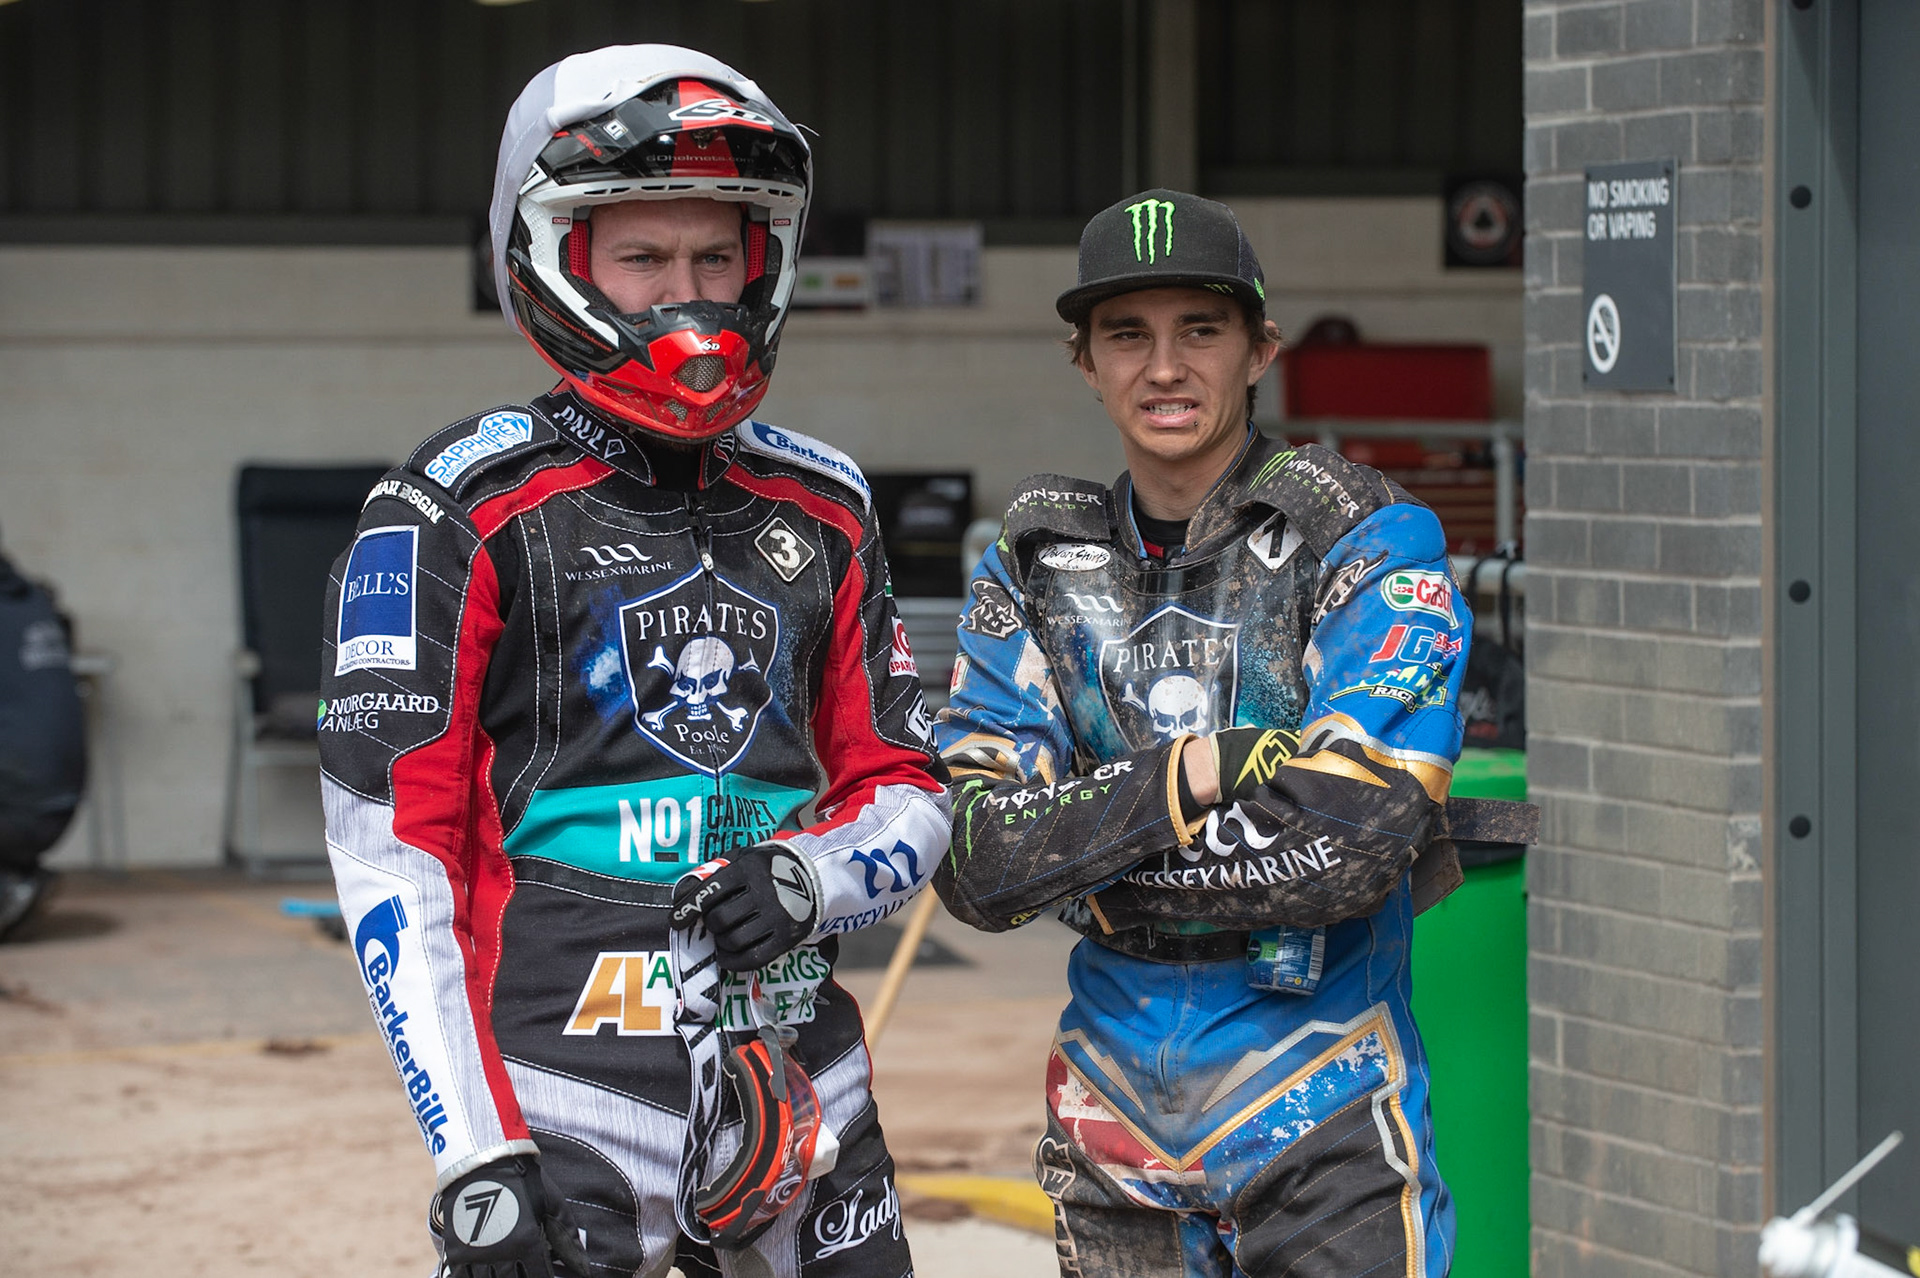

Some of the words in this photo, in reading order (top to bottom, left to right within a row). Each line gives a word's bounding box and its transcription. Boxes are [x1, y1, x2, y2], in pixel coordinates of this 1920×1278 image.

[1588, 181, 1608, 209] NO
[1610, 179, 1670, 206] SMOKING
[1587, 213, 1607, 241] OR
[1609, 211, 1656, 240] VAPING
[427, 424, 516, 480] SAPPHIRE
[442, 445, 493, 485] ENGINEERING
[776, 435, 872, 496] BarkerBille
[769, 529, 800, 569] 3
[565, 560, 676, 582] WESSEXMARINE
[345, 572, 409, 603] BELL'S
[635, 602, 768, 641] PIRATES
[345, 640, 394, 661] DECOR
[358, 657, 410, 666] CONTRACTORS
[328, 692, 439, 714] NORGAARD
[321, 711, 379, 732] ANLÆG
[673, 723, 730, 743] Poole
[707, 794, 777, 829] CARPET
[368, 951, 452, 1157] BarkerBille
[814, 1176, 901, 1259] Lady
